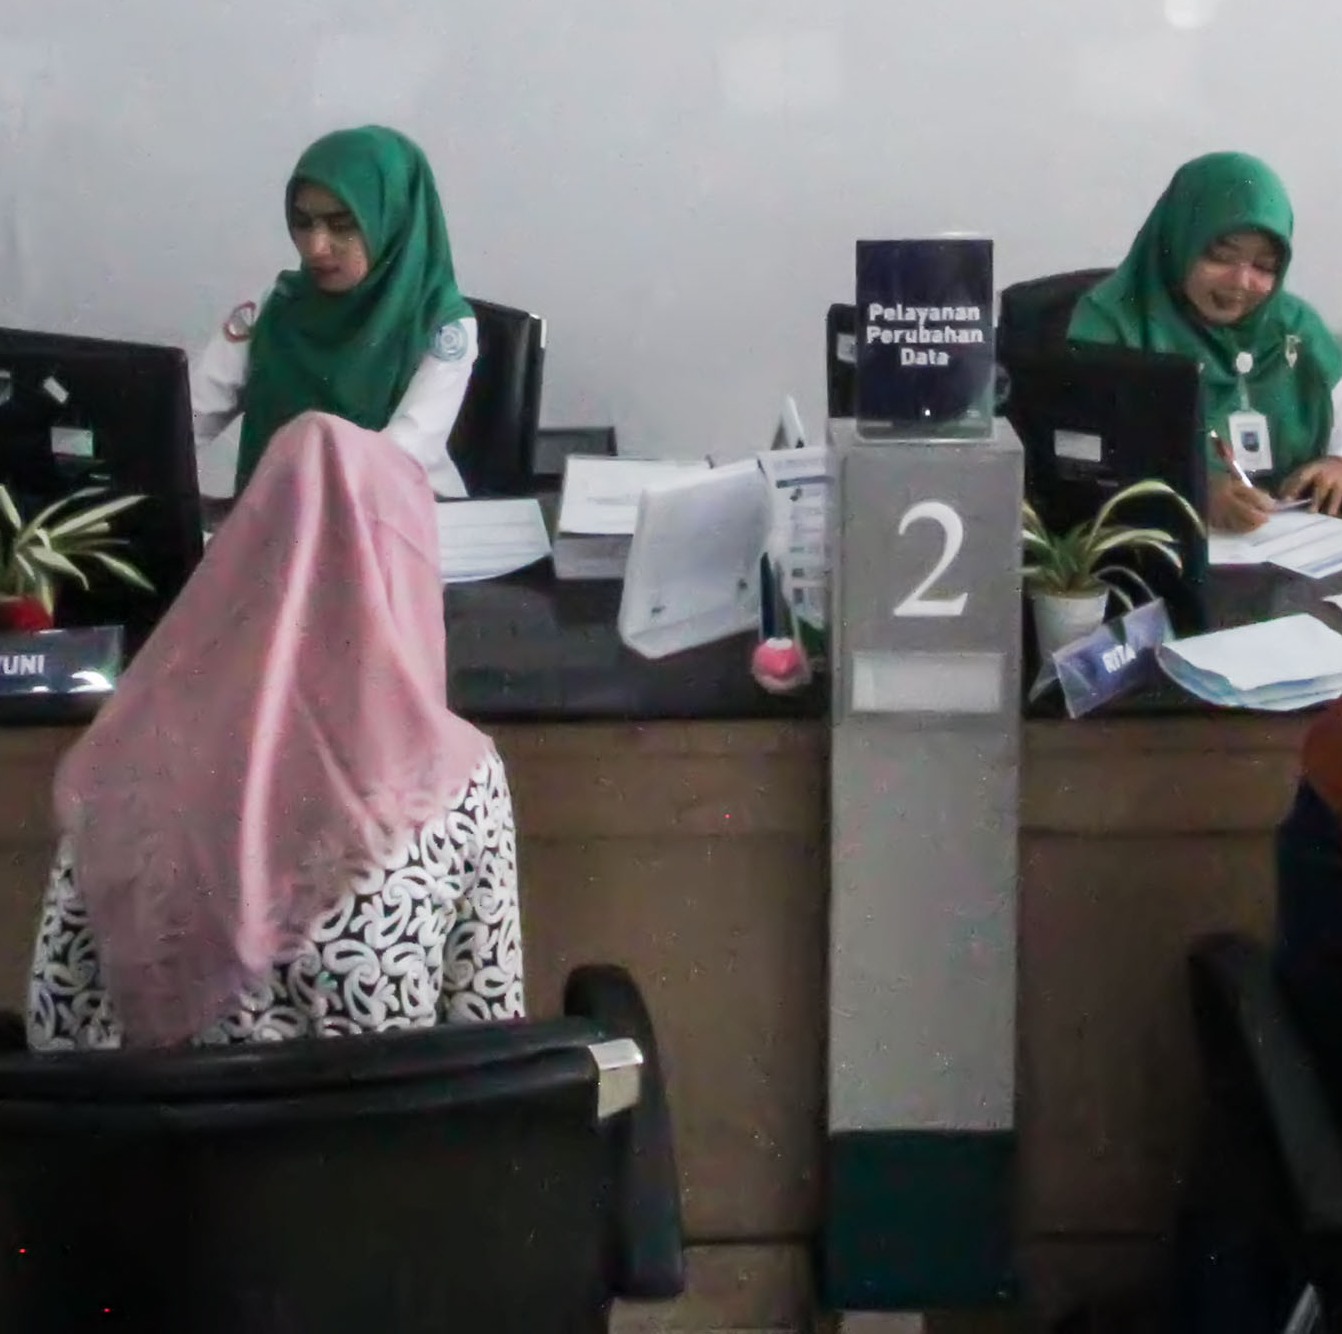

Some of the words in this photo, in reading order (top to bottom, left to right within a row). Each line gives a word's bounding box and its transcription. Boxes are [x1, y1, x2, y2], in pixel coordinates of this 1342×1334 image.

[868, 303, 980, 325] Pelayanan
[866, 326, 984, 344] Perubahan
[900, 348, 949, 366] Data
[893, 501, 969, 618] 2
